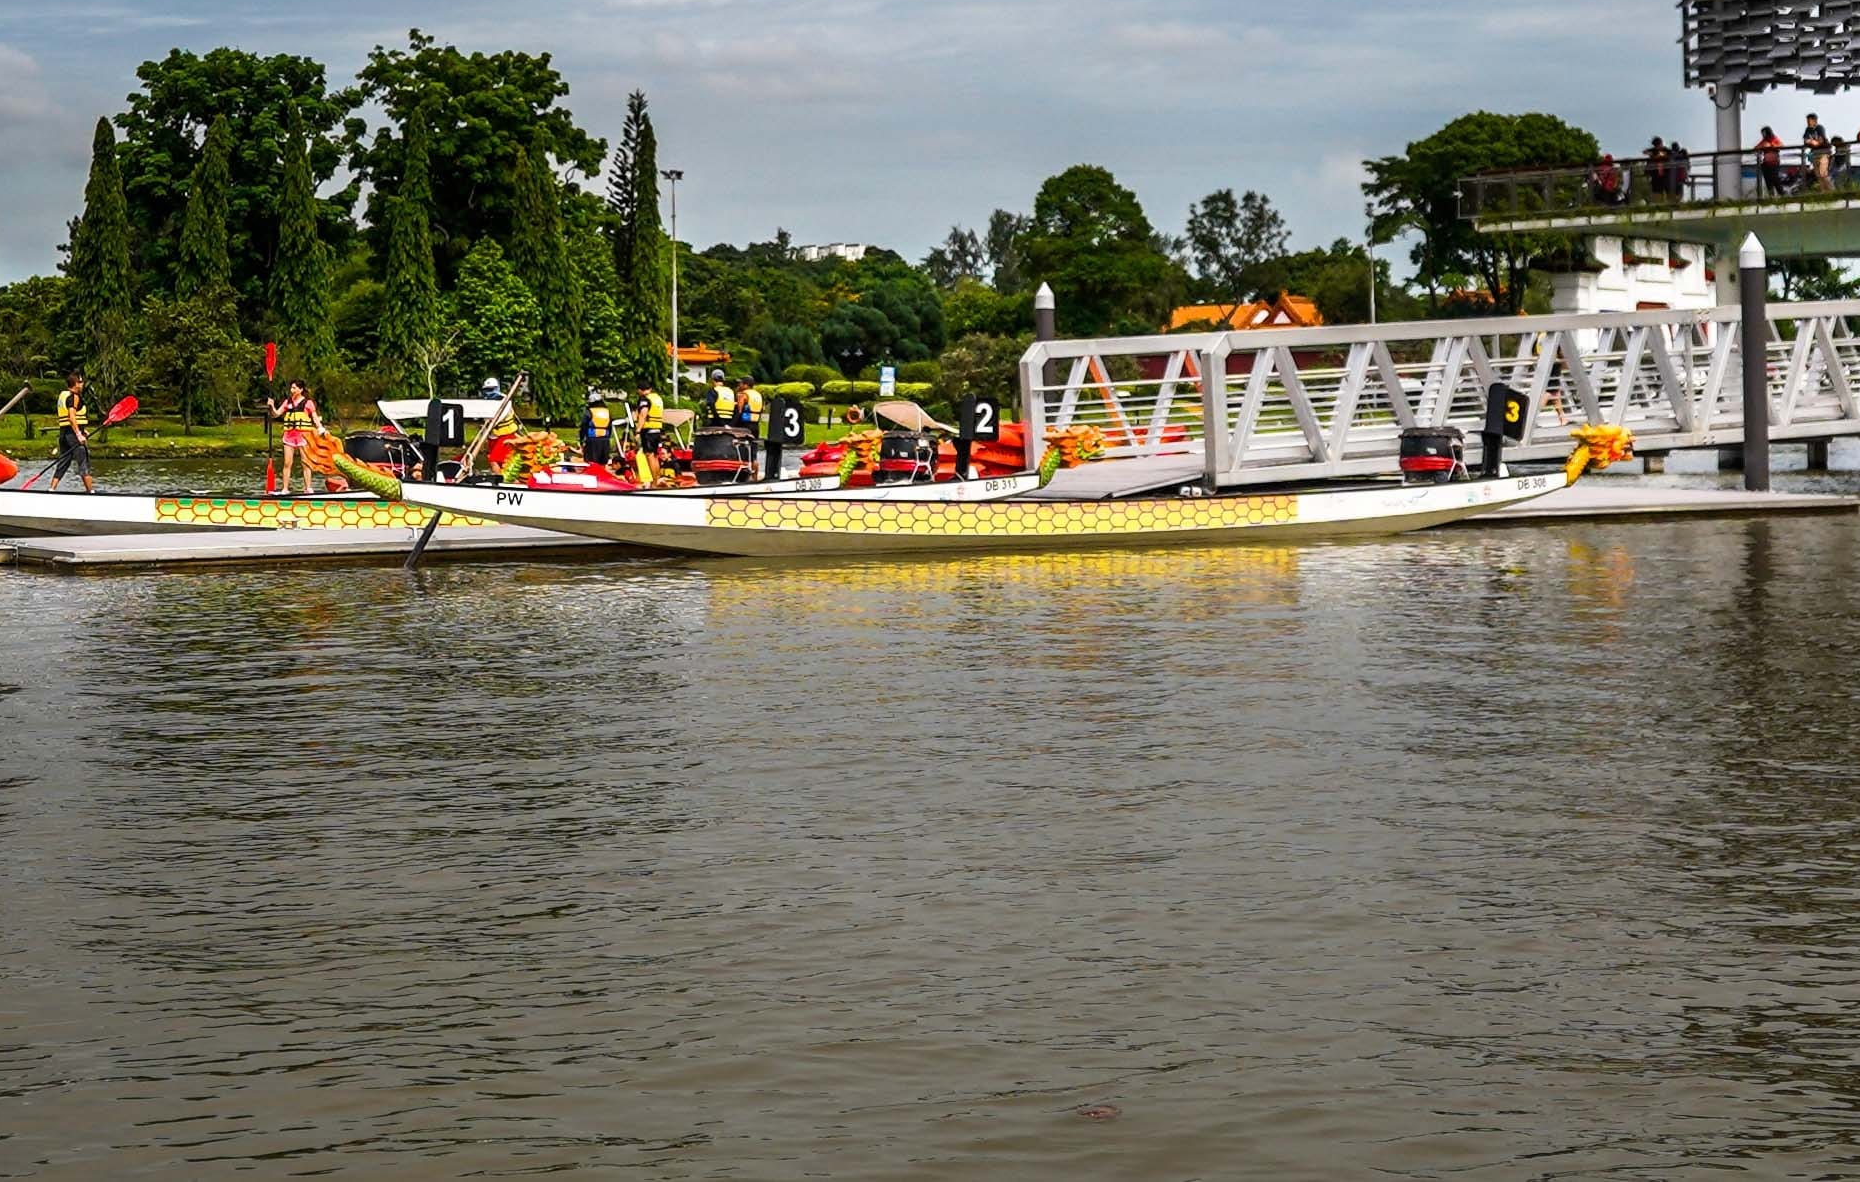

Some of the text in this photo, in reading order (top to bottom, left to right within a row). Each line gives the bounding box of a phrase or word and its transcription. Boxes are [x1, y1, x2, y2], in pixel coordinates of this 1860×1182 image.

[975, 402, 994, 434] 2
[1504, 400, 1520, 423] 3
[442, 408, 455, 439] 1
[783, 407, 800, 438] 3
[795, 479, 807, 491] DB
[985, 480, 999, 492] DB
[1517, 478, 1531, 491] DB
[496, 491, 524, 507] PW
